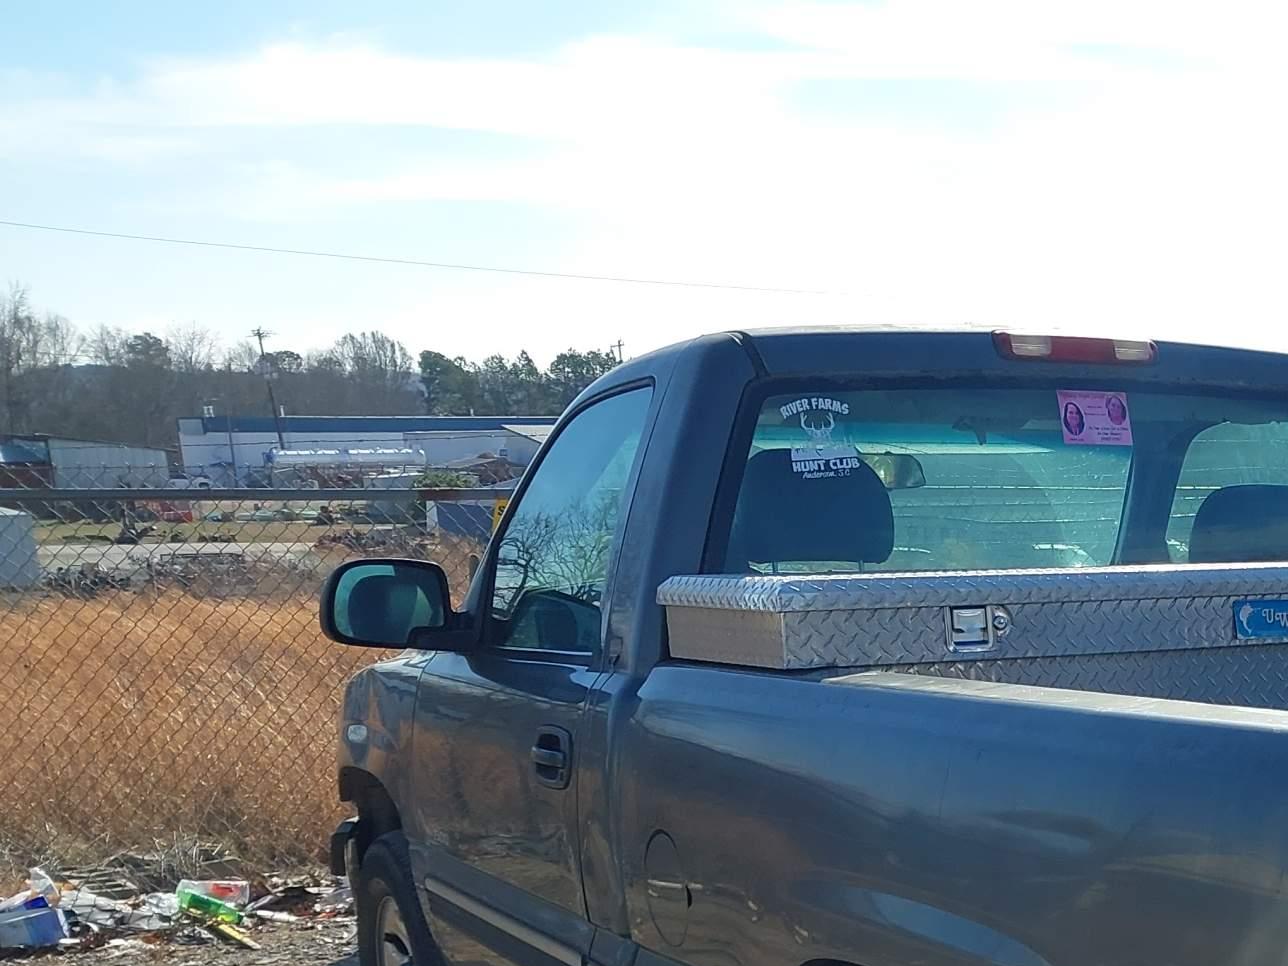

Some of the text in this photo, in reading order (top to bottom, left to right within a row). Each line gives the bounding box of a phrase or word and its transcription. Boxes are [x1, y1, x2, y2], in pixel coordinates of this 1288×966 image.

[780, 398, 849, 419] RIVER FARMS
[792, 457, 860, 473] HUNT CLUB
